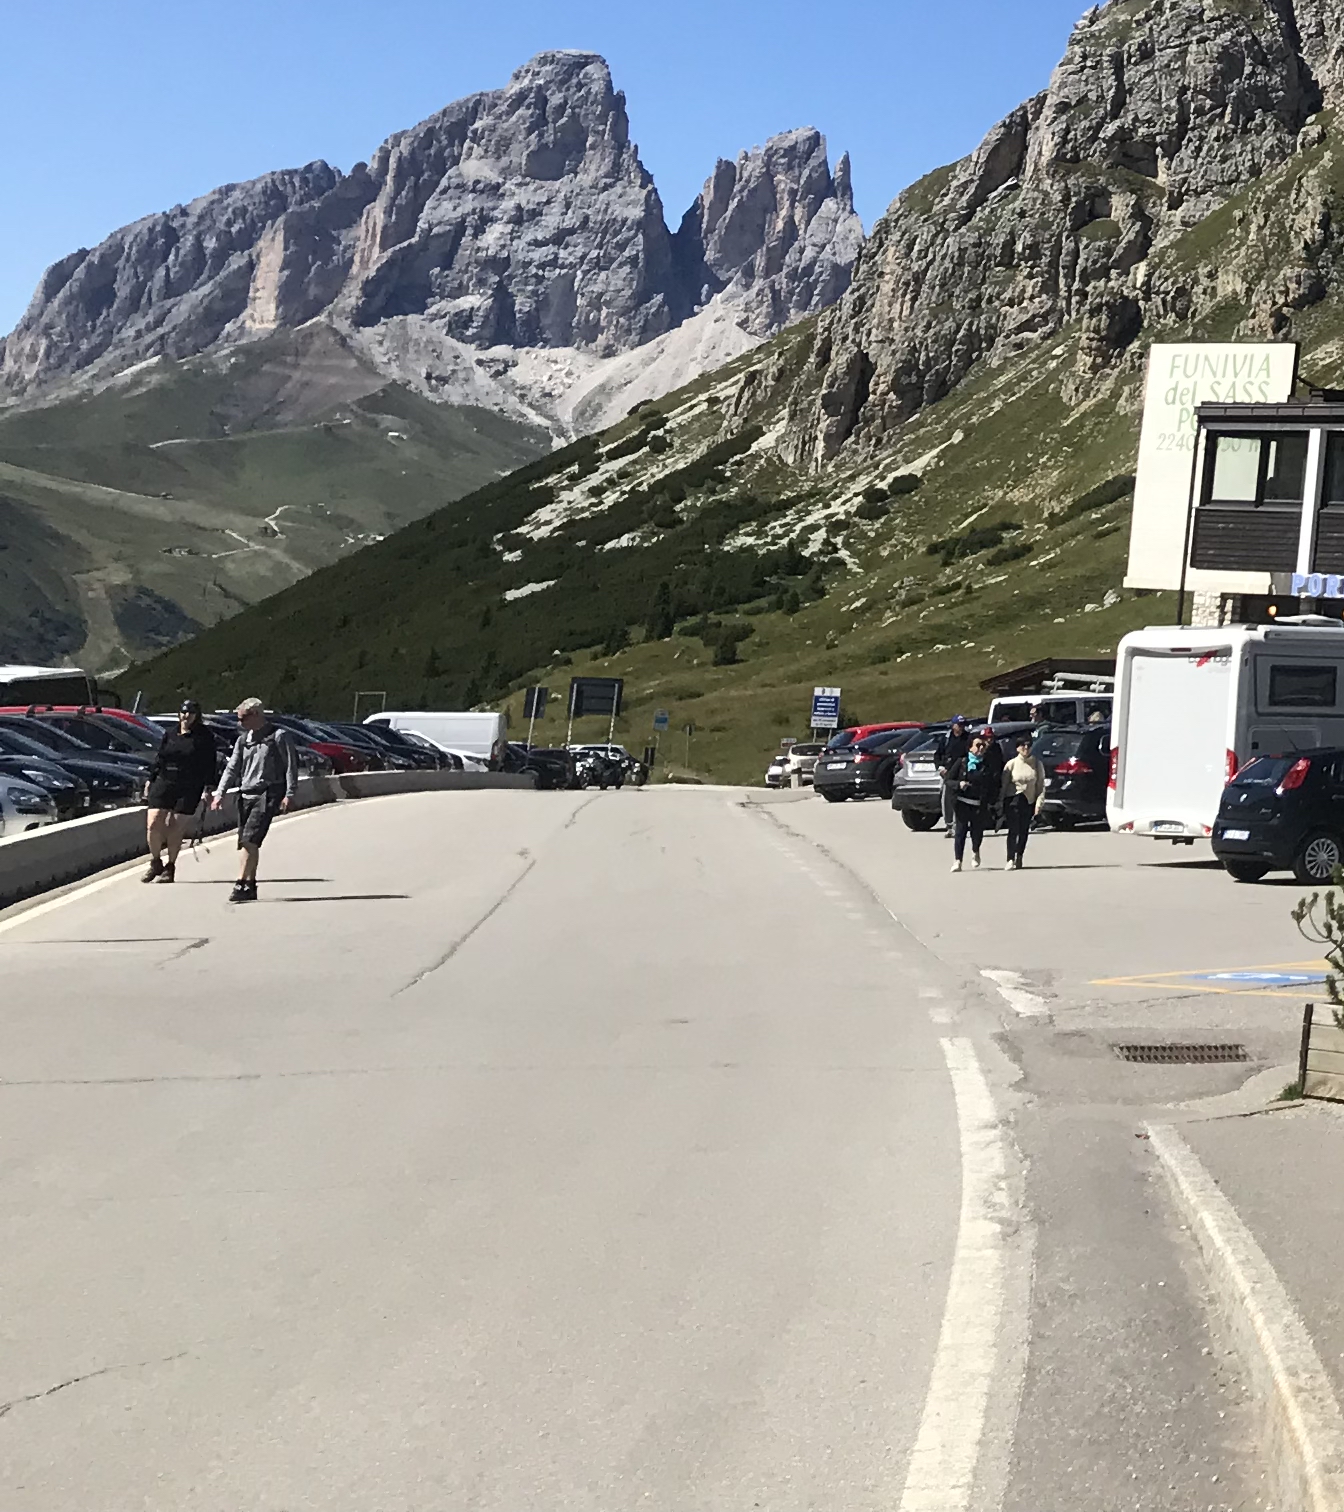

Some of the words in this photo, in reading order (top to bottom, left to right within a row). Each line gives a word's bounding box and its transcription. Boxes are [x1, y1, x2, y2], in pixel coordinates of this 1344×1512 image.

[1168, 353, 1272, 379] FUNIVIA
[1164, 380, 1198, 406] del
[1209, 380, 1271, 403] SASS
